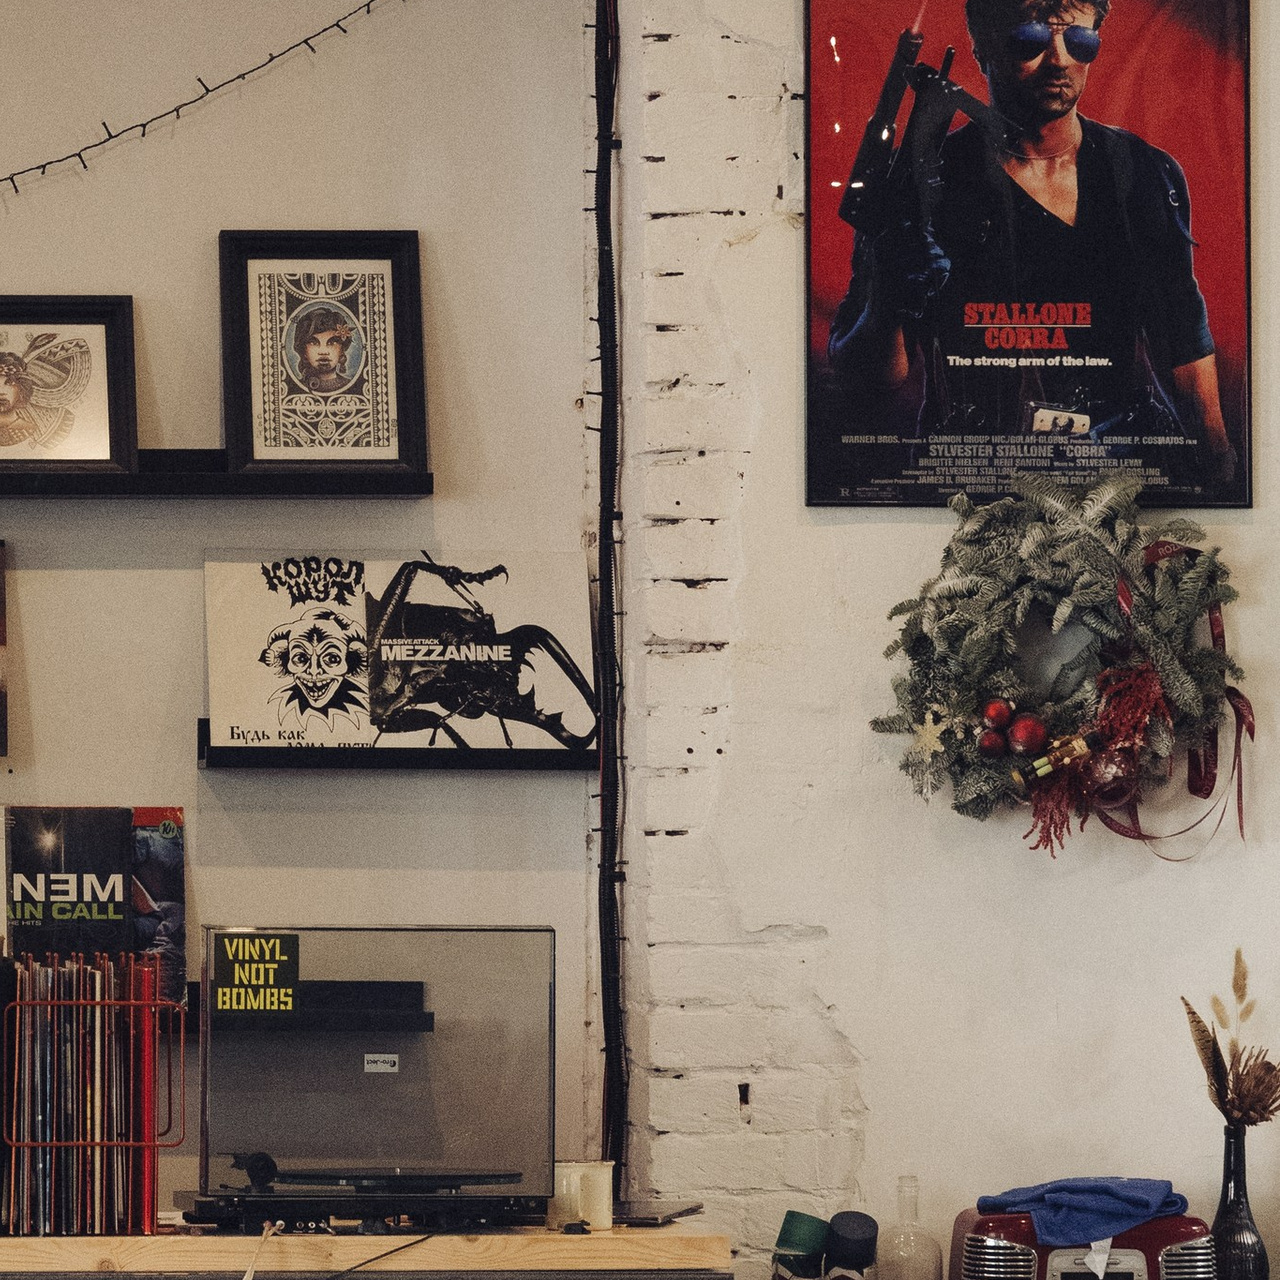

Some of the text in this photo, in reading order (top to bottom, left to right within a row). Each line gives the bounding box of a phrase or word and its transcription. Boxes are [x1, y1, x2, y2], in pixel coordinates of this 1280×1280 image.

[963, 302, 1092, 325] STALLONE
[984, 327, 1069, 350] COBRA
[947, 355, 1113, 368] The strong arm of the law.
[841, 435, 876, 443] WARNER
[928, 435, 962, 443] CANNON
[963, 435, 990, 443] GROUP
[1103, 436, 1132, 444] GEORGE
[1142, 436, 1185, 445] COSMATOS
[929, 444, 993, 457] SYLVESTER
[996, 445, 1054, 457] STALLONE
[918, 458, 954, 466] BRIGITTE
[954, 458, 989, 467] NIELSEN
[1015, 458, 1051, 467] SANTONI
[1076, 459, 1118, 467] SYLVESTER
[1120, 459, 1143, 467] LEVAY
[935, 467, 978, 475] SYLVESTER
[916, 476, 945, 484] JAMES
[955, 476, 997, 484] BRUBAKER
[261, 556, 365, 595] КОРОЛ
[380, 644, 512, 661] MEZZANINE
[229, 725, 305, 745] Будь как
[13, 873, 123, 902] NEM
[6, 902, 124, 920] AIN CALL
[224, 938, 288, 960] VINYL
[234, 963, 278, 985] NOT
[217, 987, 293, 1010] BOMBS
